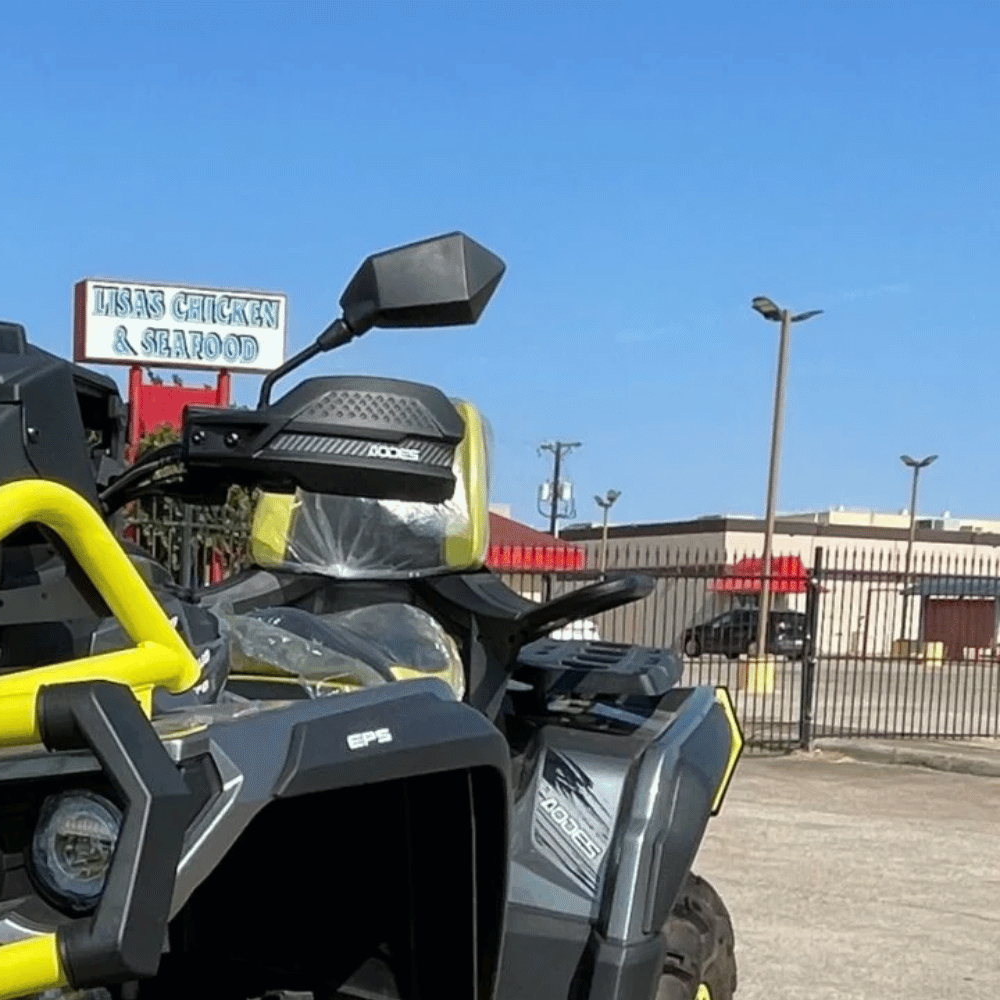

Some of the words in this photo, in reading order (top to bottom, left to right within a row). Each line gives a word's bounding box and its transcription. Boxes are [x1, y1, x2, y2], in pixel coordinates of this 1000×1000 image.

[92, 285, 165, 319] LISAS
[170, 291, 281, 329] CHICKEN
[112, 325, 139, 356] &
[141, 327, 259, 362] SEAFOOD
[346, 727, 393, 750] EPS
